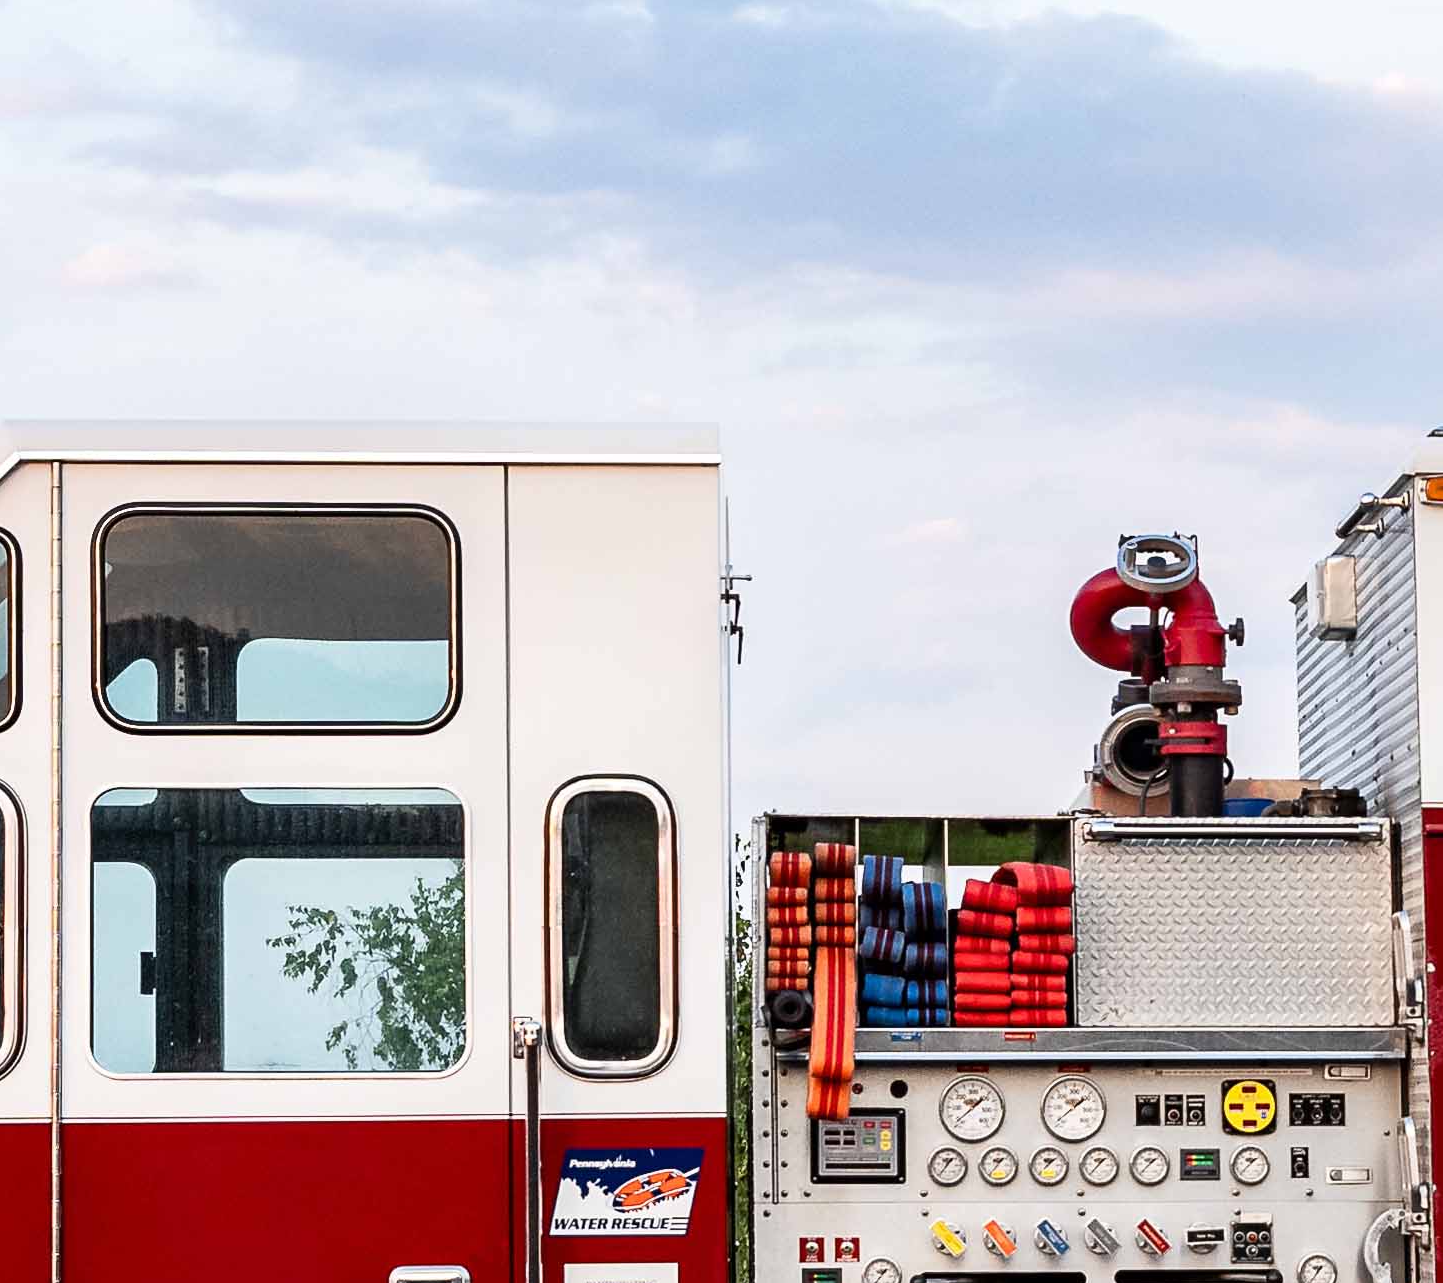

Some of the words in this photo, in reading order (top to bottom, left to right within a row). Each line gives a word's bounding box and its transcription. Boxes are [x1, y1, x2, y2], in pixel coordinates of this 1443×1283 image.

[569, 1158, 636, 1170] Pennsylvania
[554, 1218, 608, 1230] WATER
[611, 1217, 670, 1230] RESCUE
